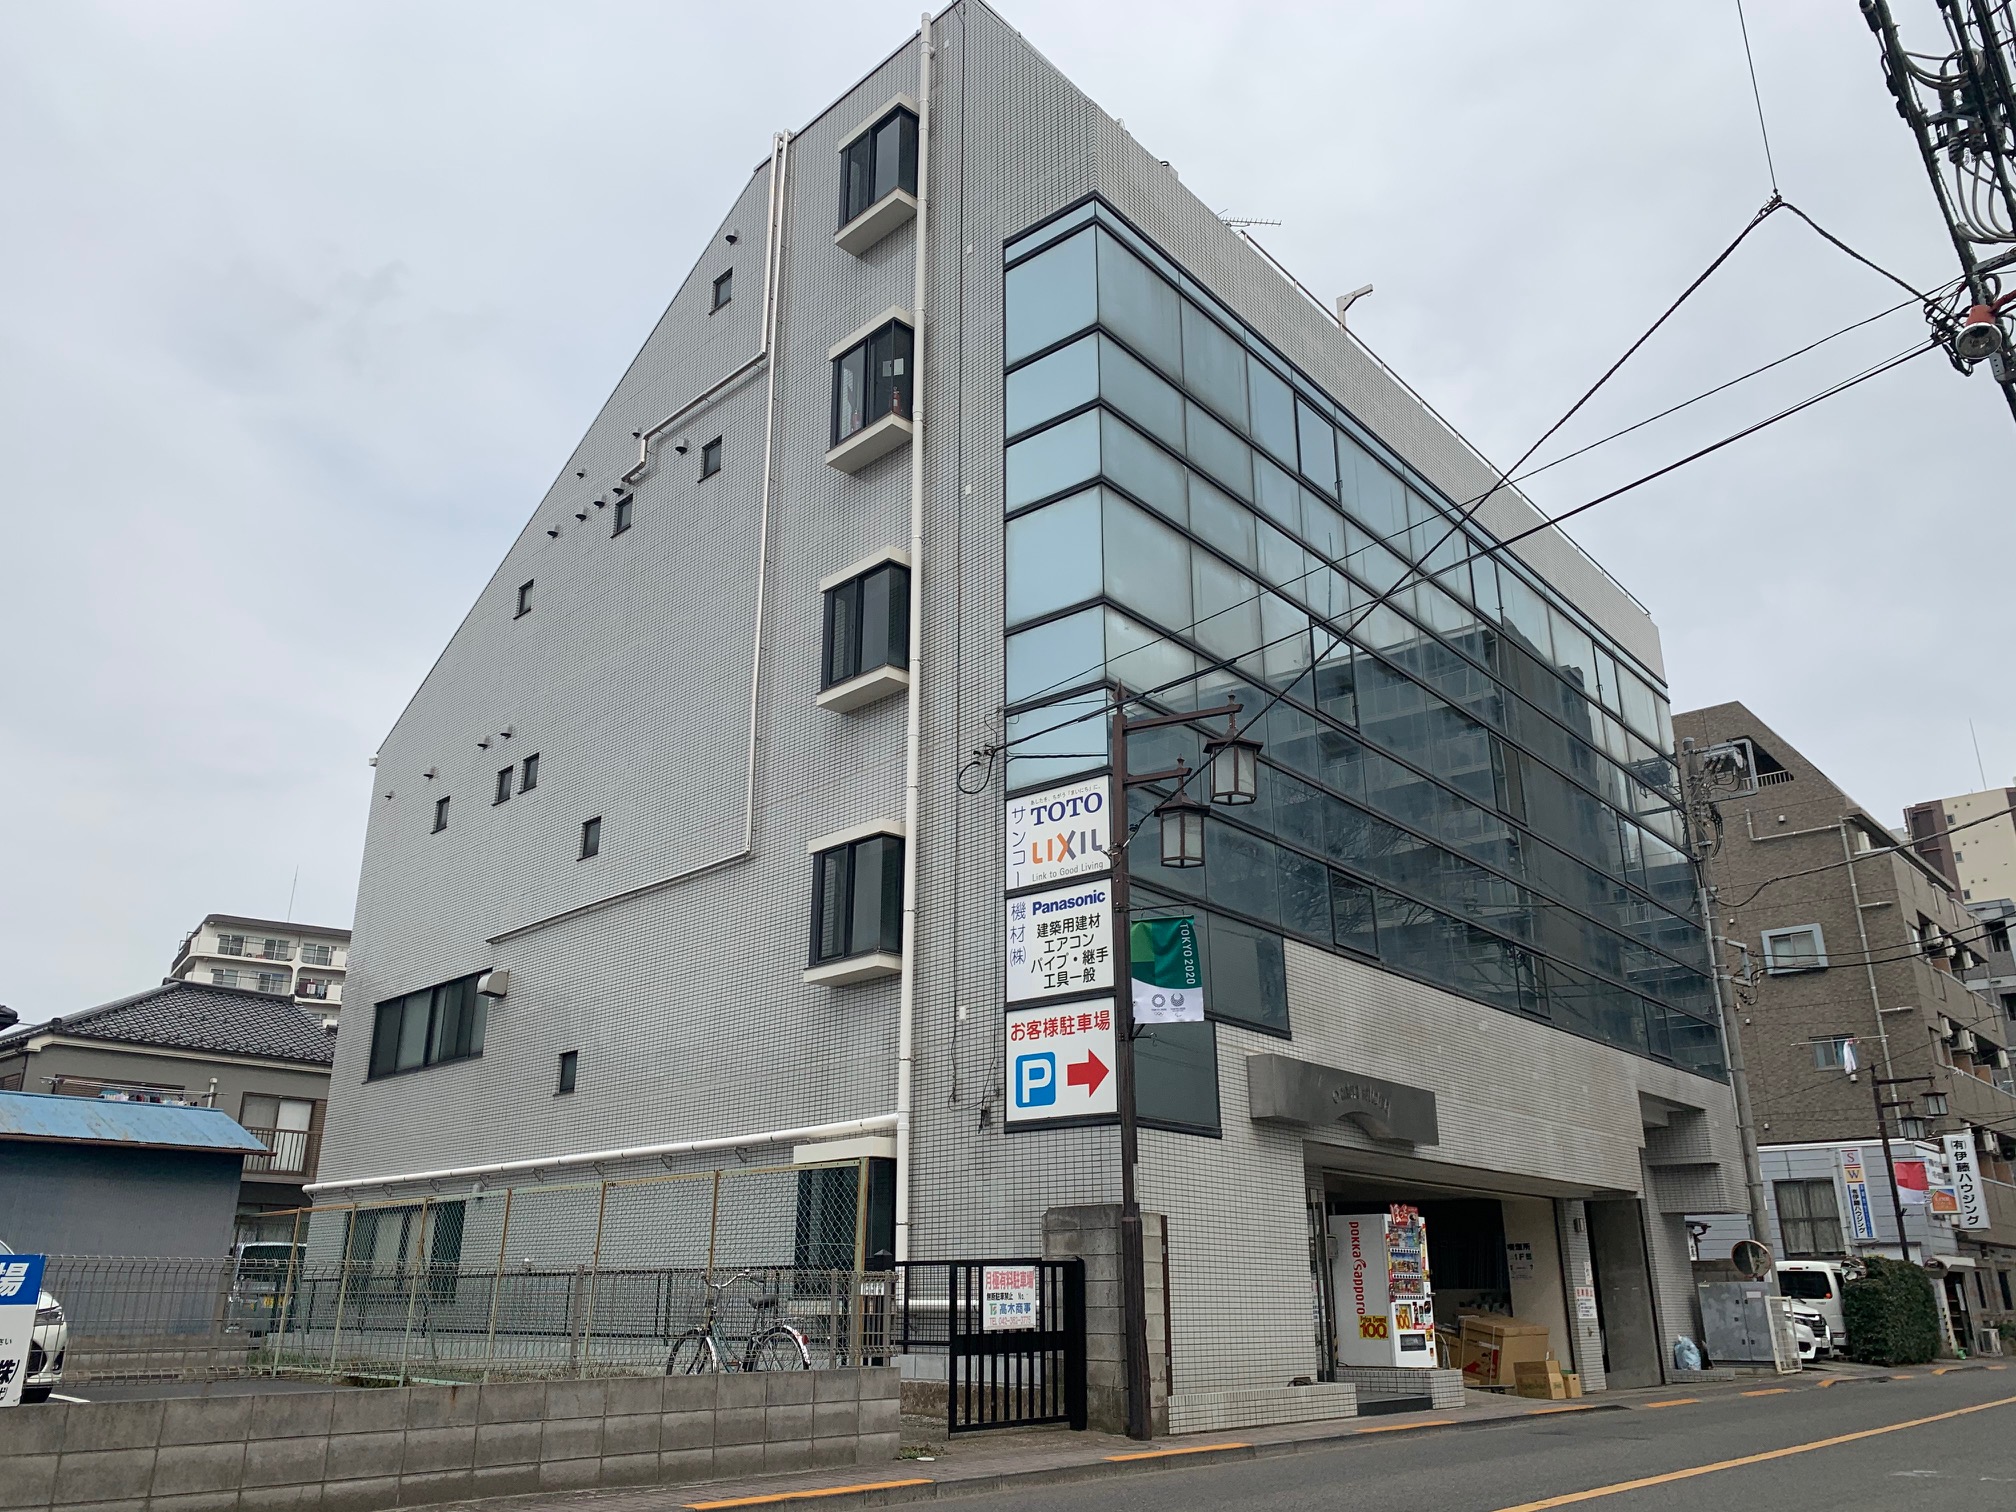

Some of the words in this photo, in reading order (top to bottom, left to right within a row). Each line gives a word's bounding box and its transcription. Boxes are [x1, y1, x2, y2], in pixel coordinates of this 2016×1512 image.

[1030, 792, 1103, 826] TOTO
[1011, 805, 1026, 887] サンコー
[1032, 828, 1103, 864] LIXIL
[1032, 871, 1047, 882] Link
[1049, 870, 1057, 878] to
[1060, 865, 1079, 876] Good
[1081, 861, 1104, 872] Living
[1032, 889, 1106, 916] Panasonic
[1036, 912, 1101, 939] 建築用建材
[1043, 934, 1095, 954] エアコン
[1180, 923, 1193, 957] TOKYO
[1031, 946, 1109, 973] パイプ・継手
[1184, 959, 1196, 985] 2020
[1043, 967, 1096, 989] 工具一般
[1010, 1010, 1111, 1041] お客様駐車場
[1022, 1058, 1052, 1104] P
[1846, 1152, 1855, 1163] S
